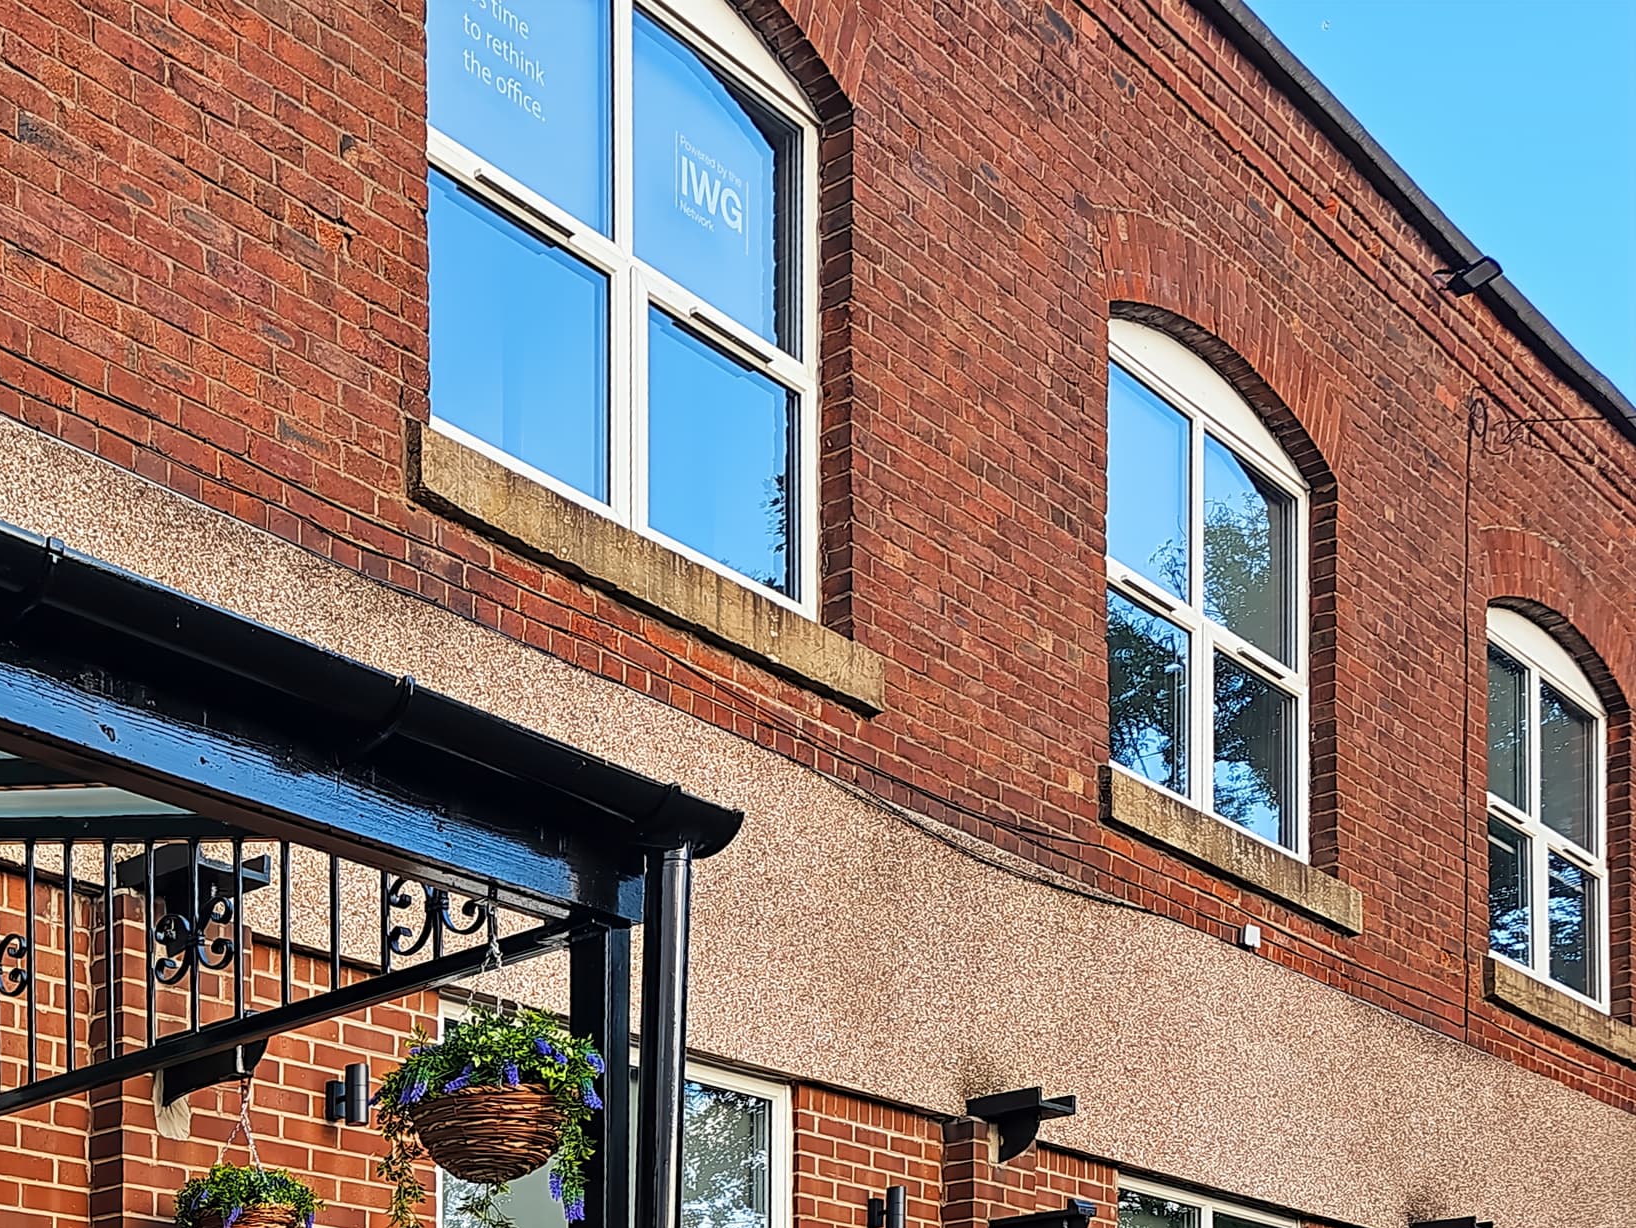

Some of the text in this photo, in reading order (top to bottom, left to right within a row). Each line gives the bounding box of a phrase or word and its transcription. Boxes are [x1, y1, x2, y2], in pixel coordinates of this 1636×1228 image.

[463, 12, 545, 87] to rethink
[491, 0, 529, 40] time
[463, 48, 546, 122] the office.
[681, 154, 743, 235] IWG
